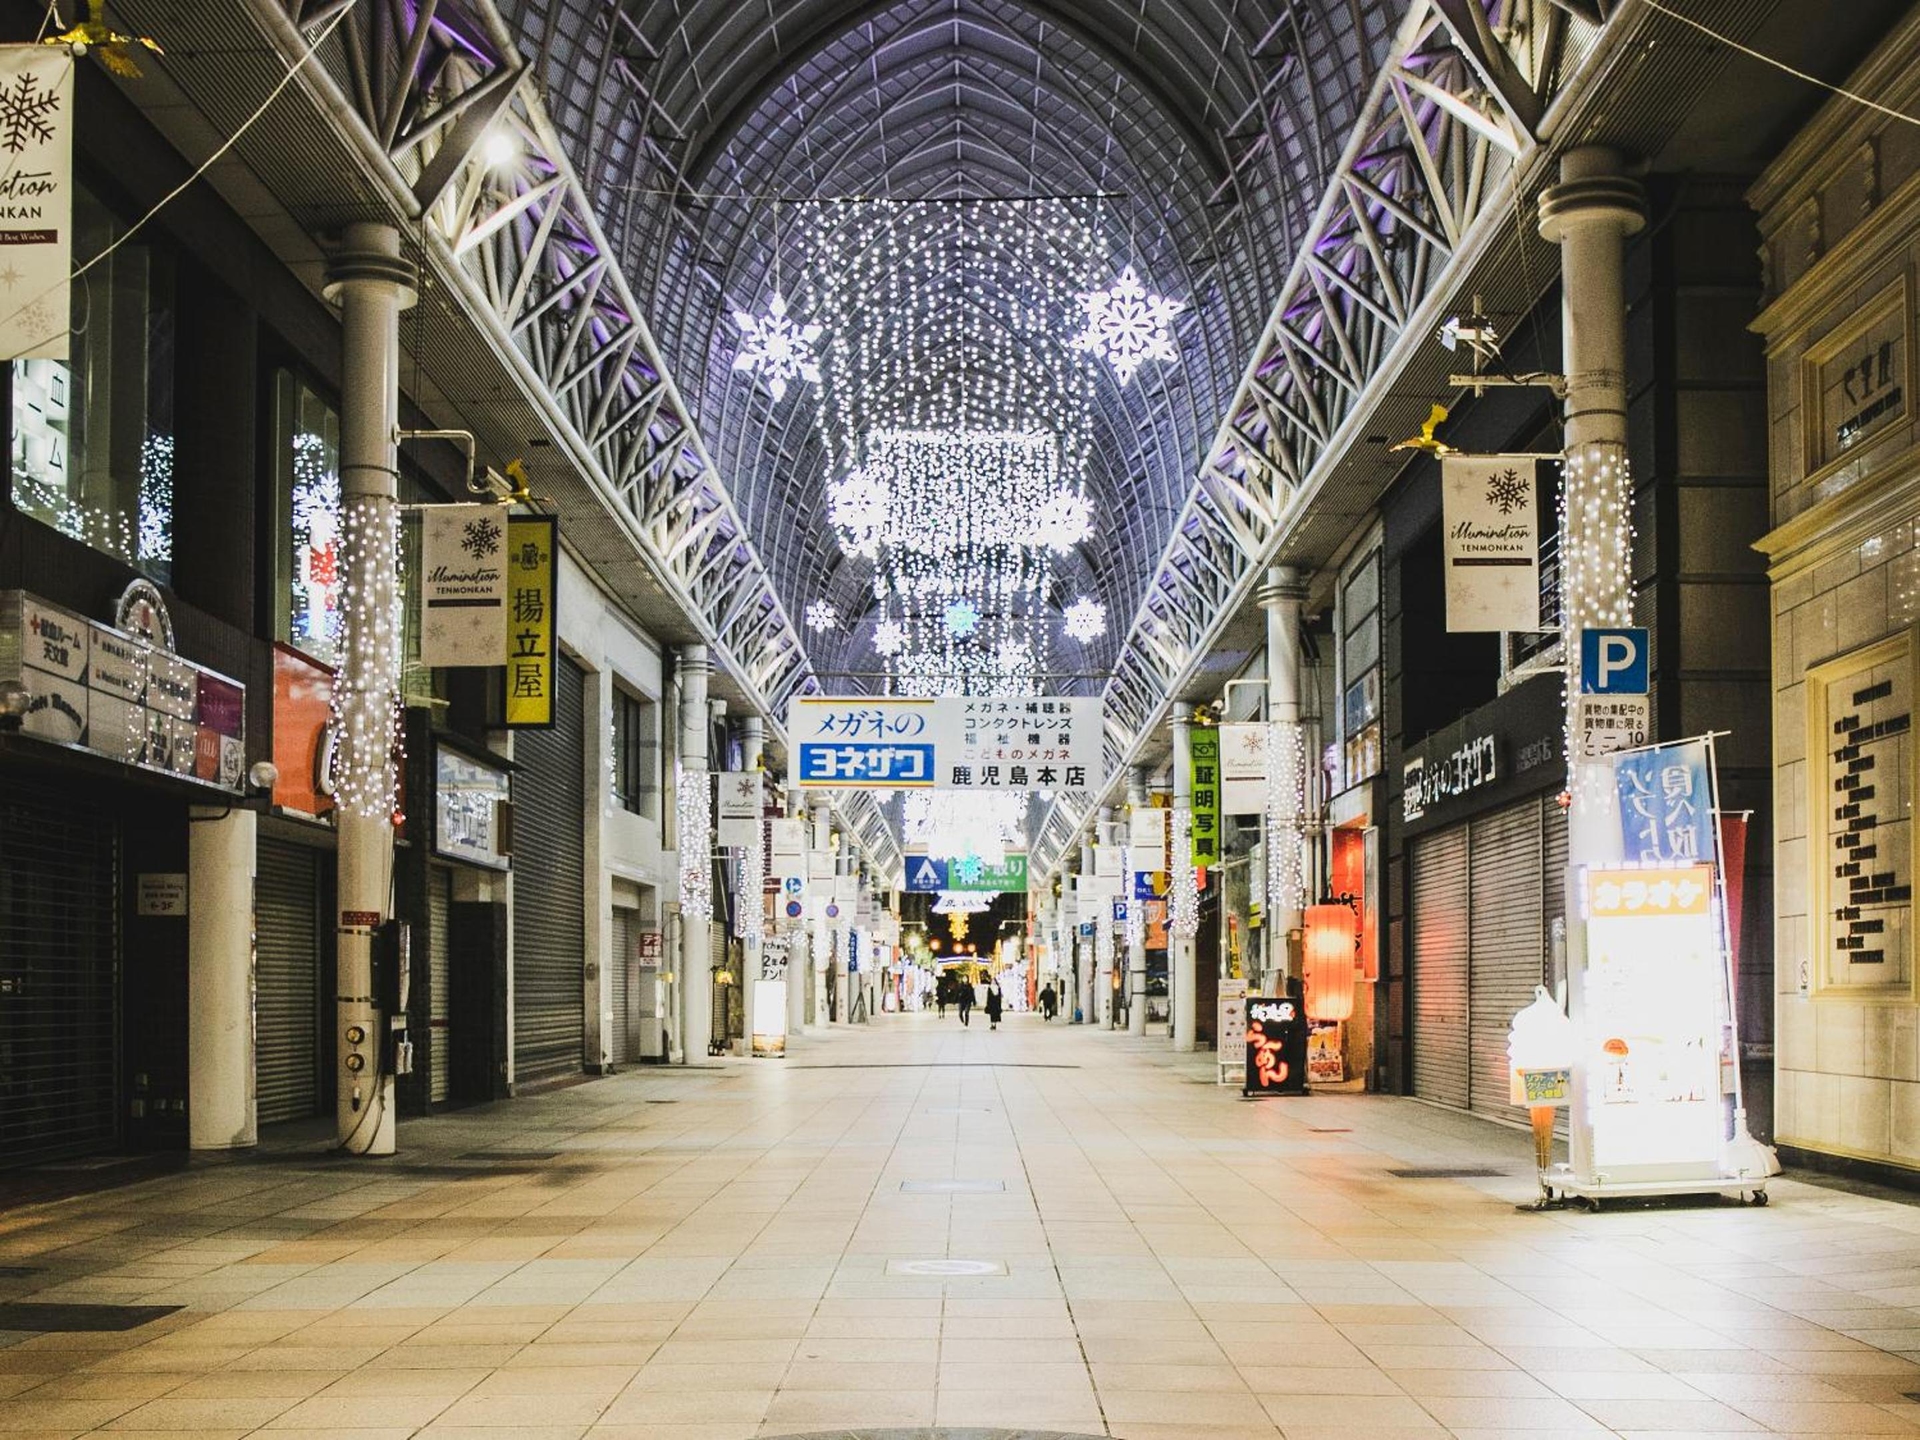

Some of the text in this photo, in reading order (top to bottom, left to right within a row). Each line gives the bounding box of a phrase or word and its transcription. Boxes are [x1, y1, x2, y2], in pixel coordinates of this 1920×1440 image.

[1461, 544, 1523, 552] TENMONKAN
[437, 586, 492, 594] TENMONKAN
[512, 588, 546, 698] 揚立屋
[1598, 635, 1636, 689] P
[965, 702, 1071, 715] メガネ・補聴器
[1584, 704, 1645, 716] 貨物の集配中の
[812, 710, 925, 739] メガネの
[965, 718, 1072, 730] コンタクトレンズ
[1584, 717, 1645, 730] 貨物車に限る
[965, 733, 1070, 746] 福祉機器
[1628, 731, 1645, 744] 10
[964, 748, 1071, 760] こどものメガネ
[809, 746, 924, 778] ヨネザワ
[952, 765, 1086, 786] 鹿児島本店
[1195, 766, 1215, 857] 証明写真
[1594, 879, 1704, 911] カラオケ
[1115, 904, 1125, 919] P
[1082, 923, 1092, 935] P
[1245, 1020, 1289, 1087] らーめん
